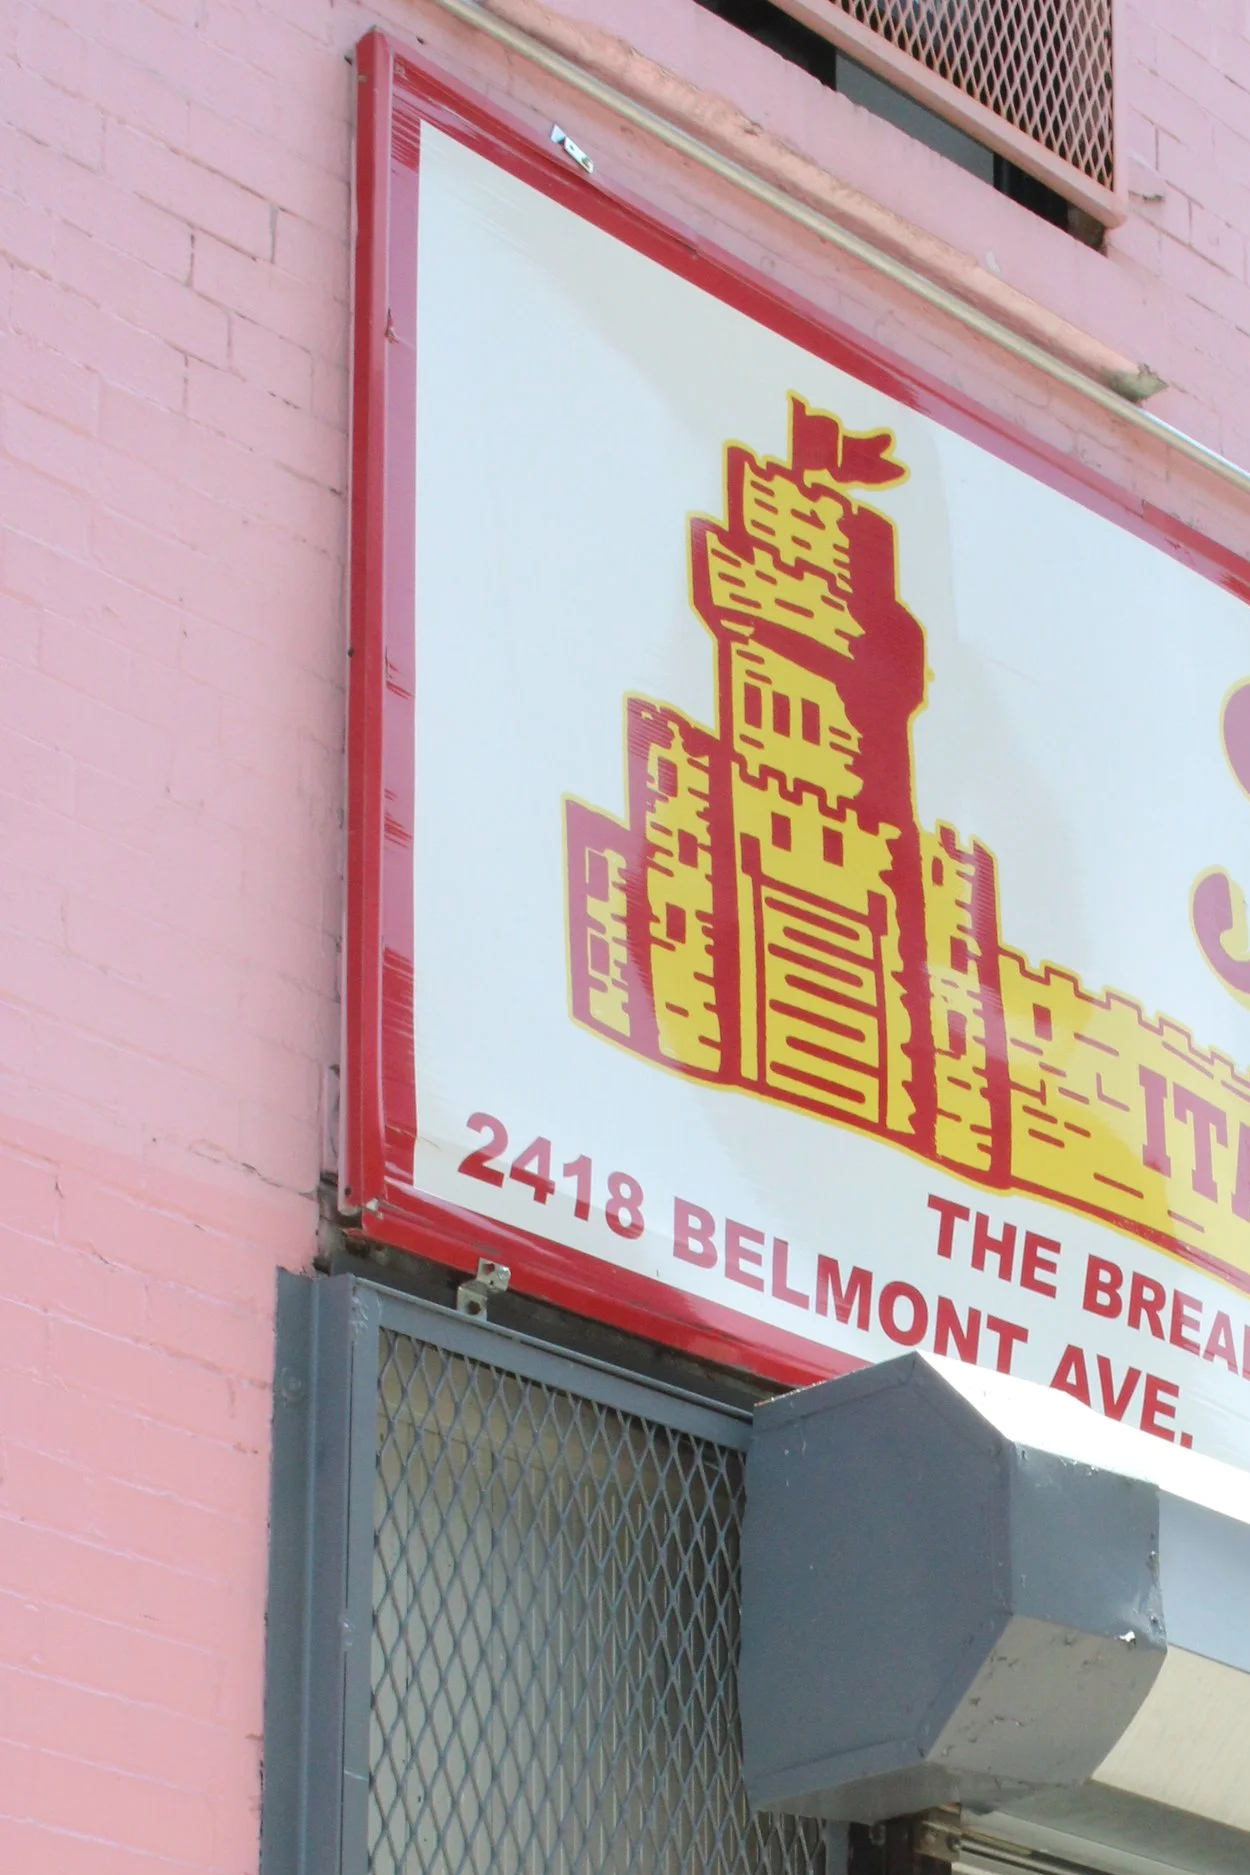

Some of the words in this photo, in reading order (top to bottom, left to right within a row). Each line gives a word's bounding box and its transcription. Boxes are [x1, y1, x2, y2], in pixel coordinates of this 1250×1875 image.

[457, 1111, 645, 1240] 2418
[672, 1196, 1029, 1375] BELMONT
[1049, 1343, 1194, 1449] AVE.
[926, 1192, 1062, 1299] THE
